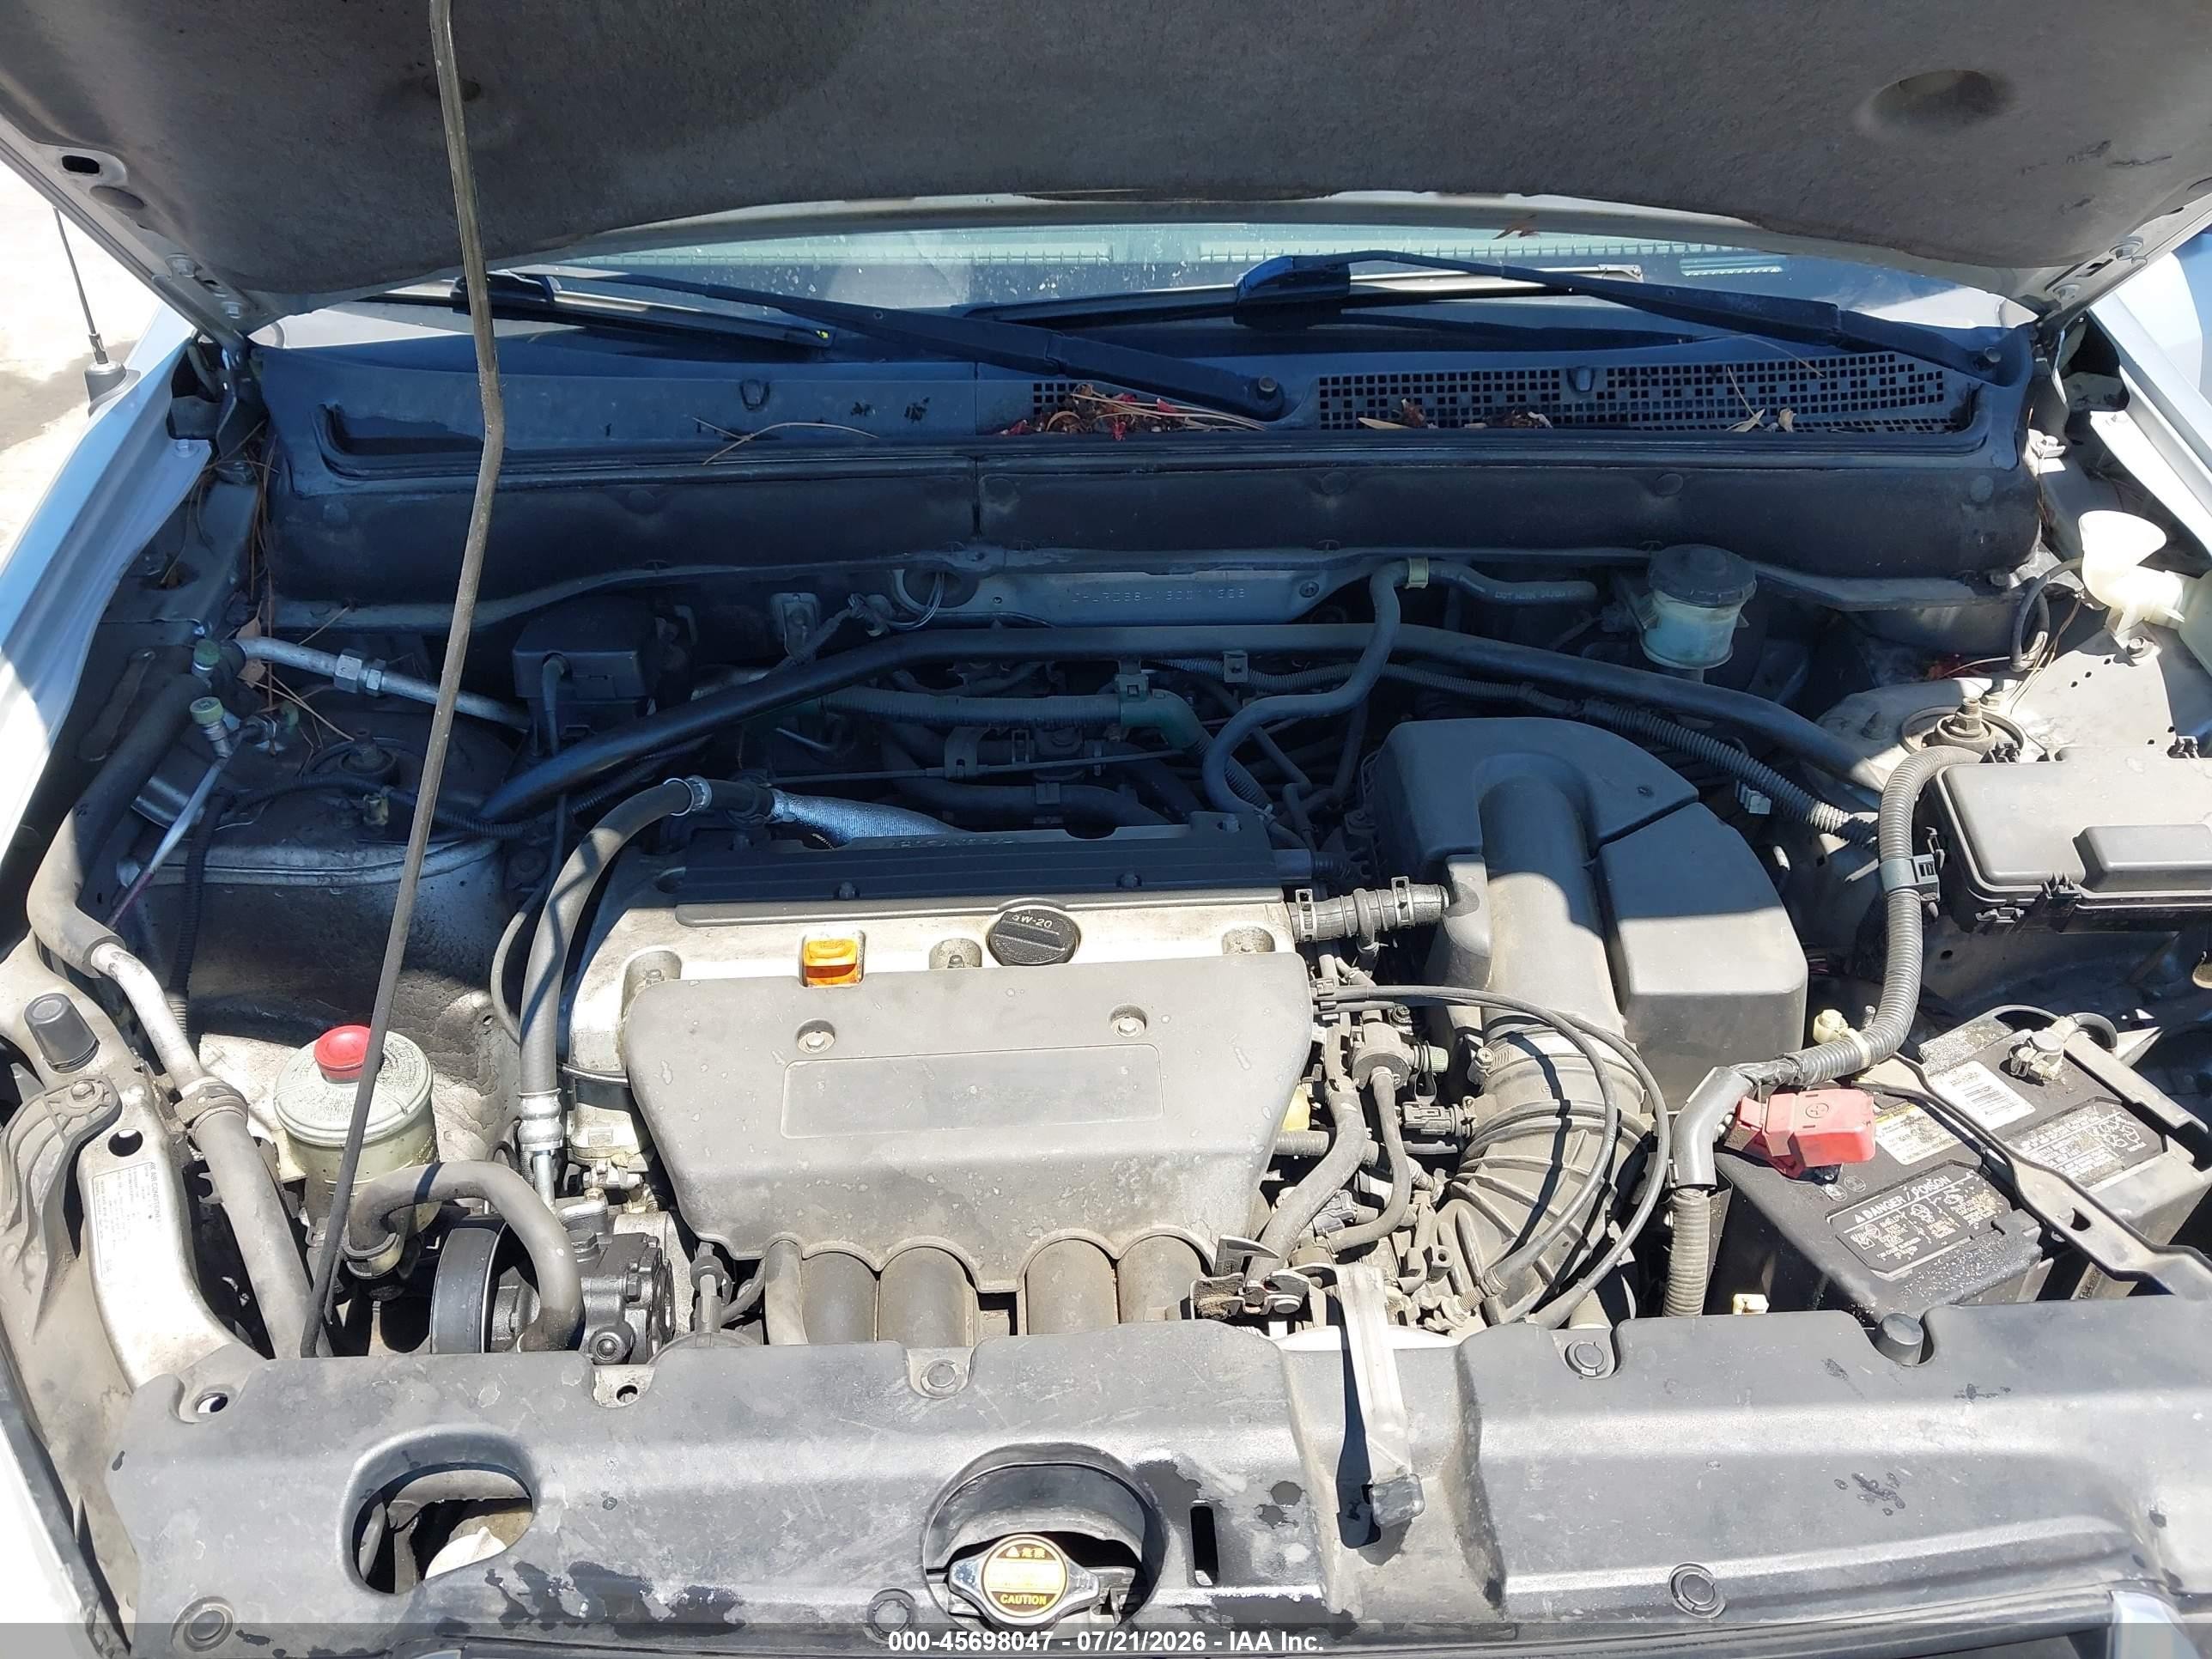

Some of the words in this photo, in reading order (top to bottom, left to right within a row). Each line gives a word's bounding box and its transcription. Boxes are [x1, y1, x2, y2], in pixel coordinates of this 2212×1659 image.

[1012, 915, 1052, 928] 5W-20
[1862, 1193, 1907, 1219] DANGER
[1912, 1175, 1952, 1200] POISON
[1000, 1594, 1047, 1605] CAUTION
